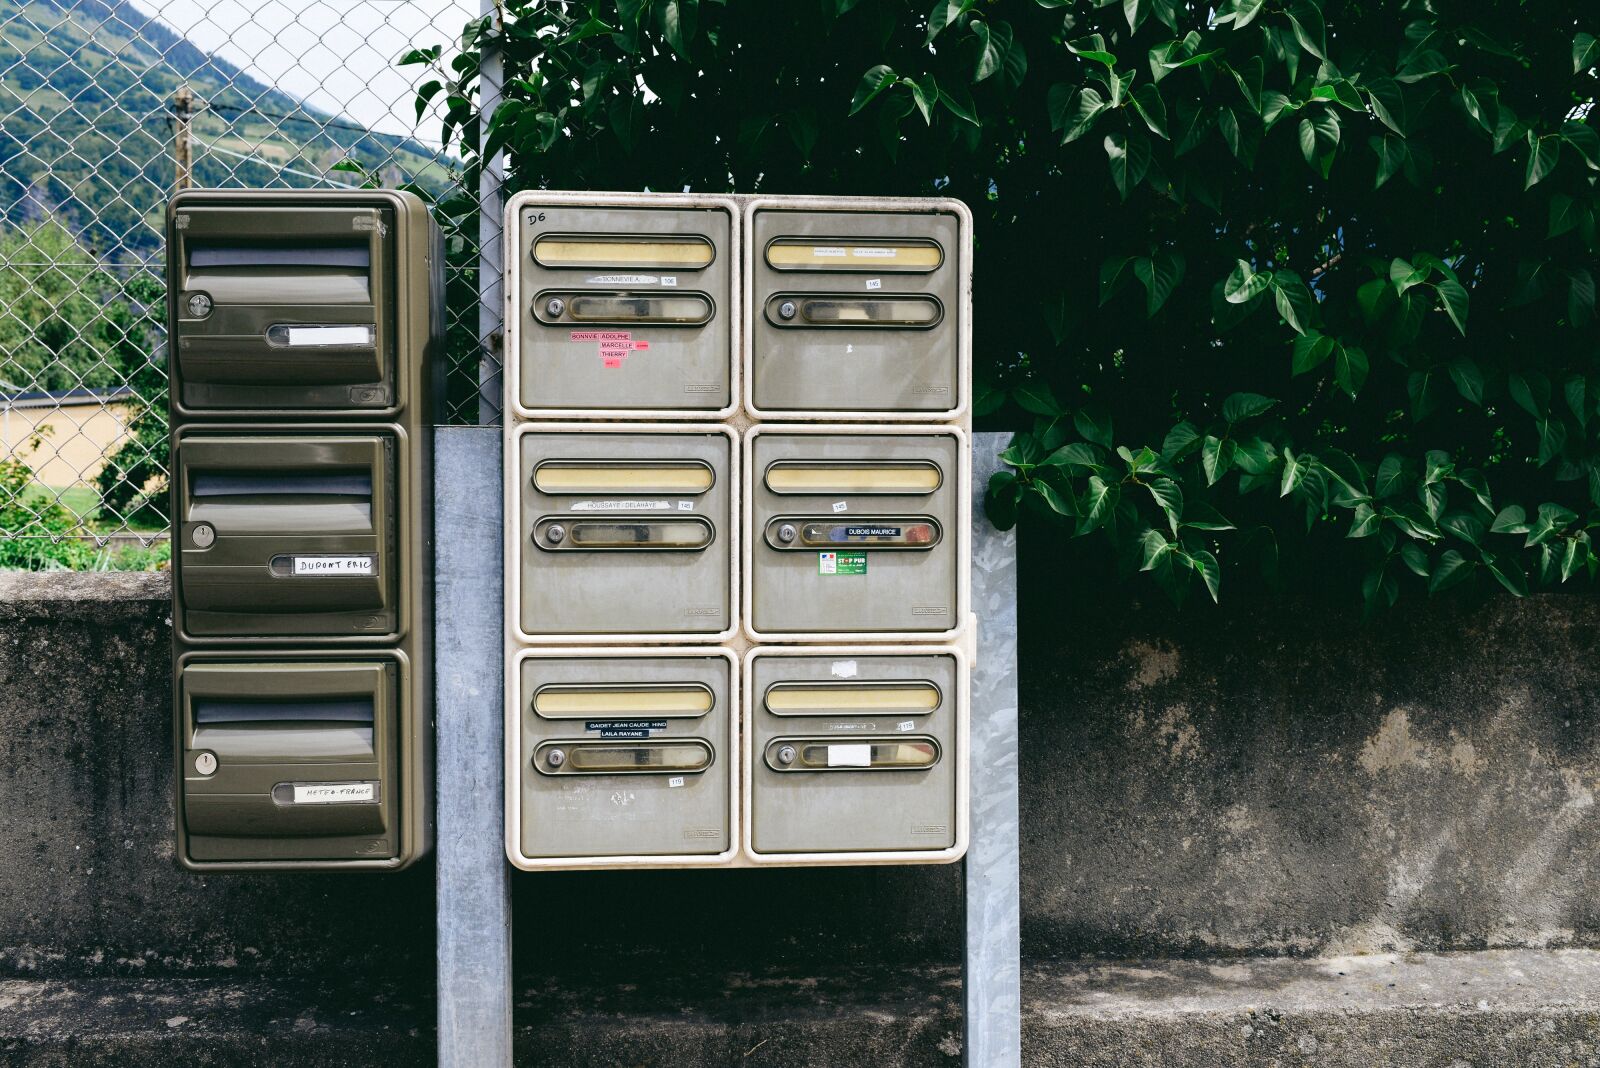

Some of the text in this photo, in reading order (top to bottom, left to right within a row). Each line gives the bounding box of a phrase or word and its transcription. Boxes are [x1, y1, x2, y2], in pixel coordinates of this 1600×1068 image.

[527, 212, 546, 225] D6
[601, 332, 629, 340] ADOLPHE
[300, 561, 373, 570] DUPONT ERIC
